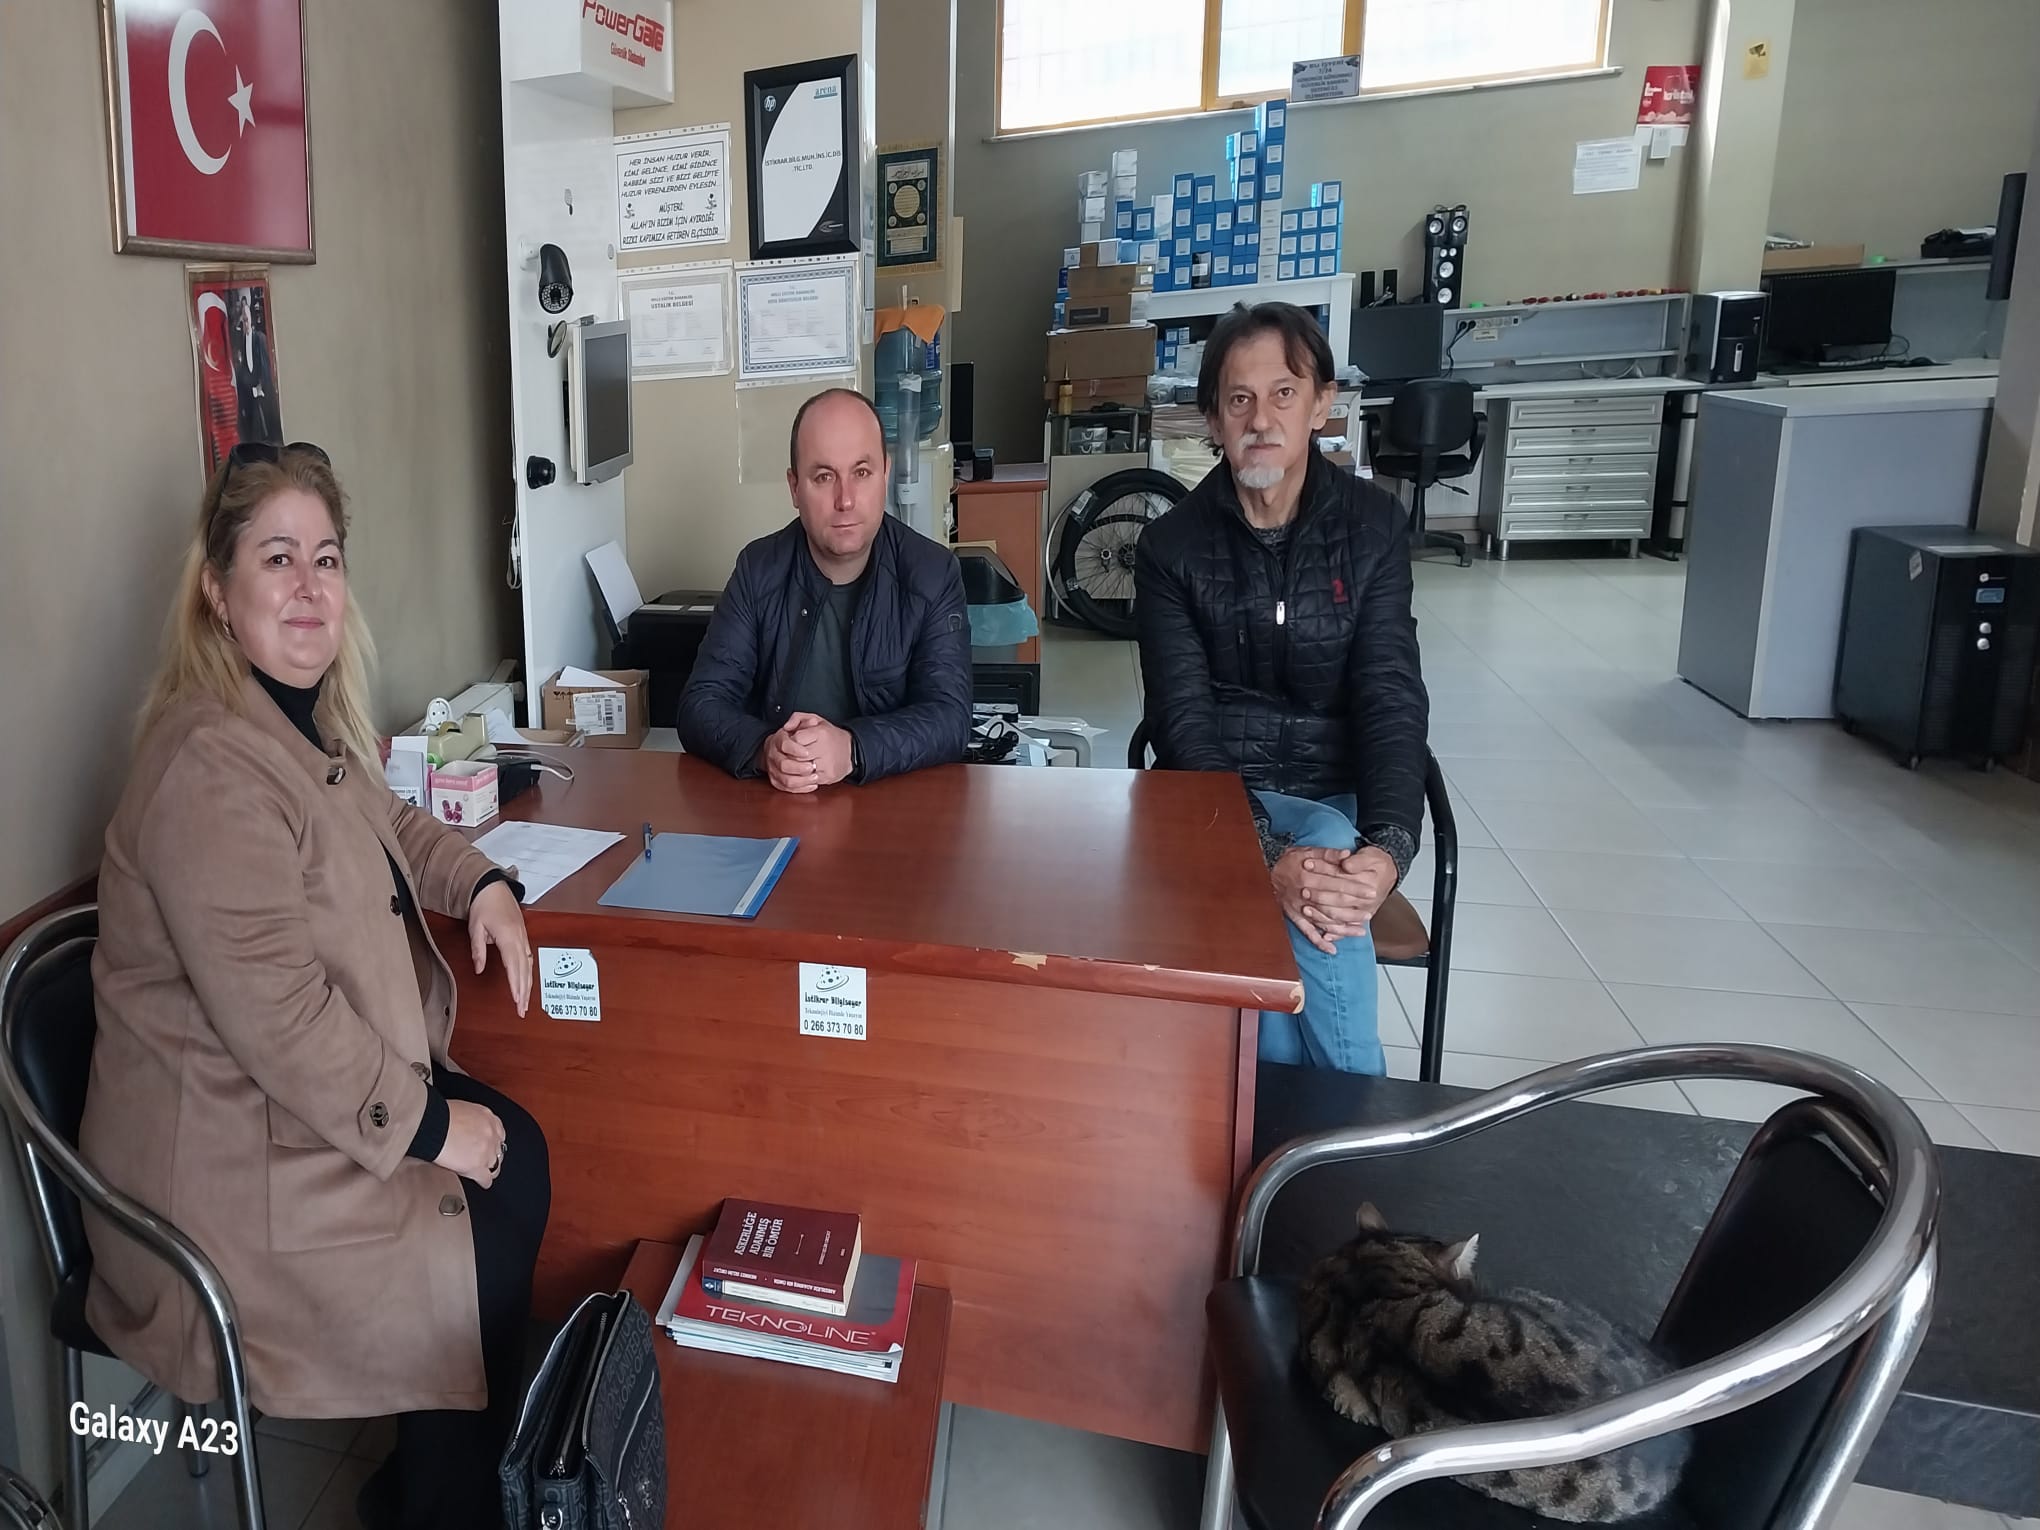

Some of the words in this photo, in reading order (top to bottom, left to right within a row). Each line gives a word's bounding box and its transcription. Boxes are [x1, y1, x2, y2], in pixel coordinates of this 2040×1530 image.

[544, 1004, 550, 1014] 0
[550, 1004, 564, 1015] 266
[564, 1005, 578, 1016] 373
[578, 1006, 588, 1016] 70
[589, 1006, 598, 1016] 80
[804, 1019, 808, 1030] 0
[810, 1020, 824, 1032] 266
[826, 1022, 840, 1033] 373
[842, 1022, 852, 1034] 70
[854, 1024, 864, 1036] 80
[734, 1211, 758, 1256] ASKERLİĞE
[749, 1217, 772, 1255] ADANMIŞ
[762, 1243, 774, 1258] BİR
[769, 1218, 784, 1245] ÖMÜR
